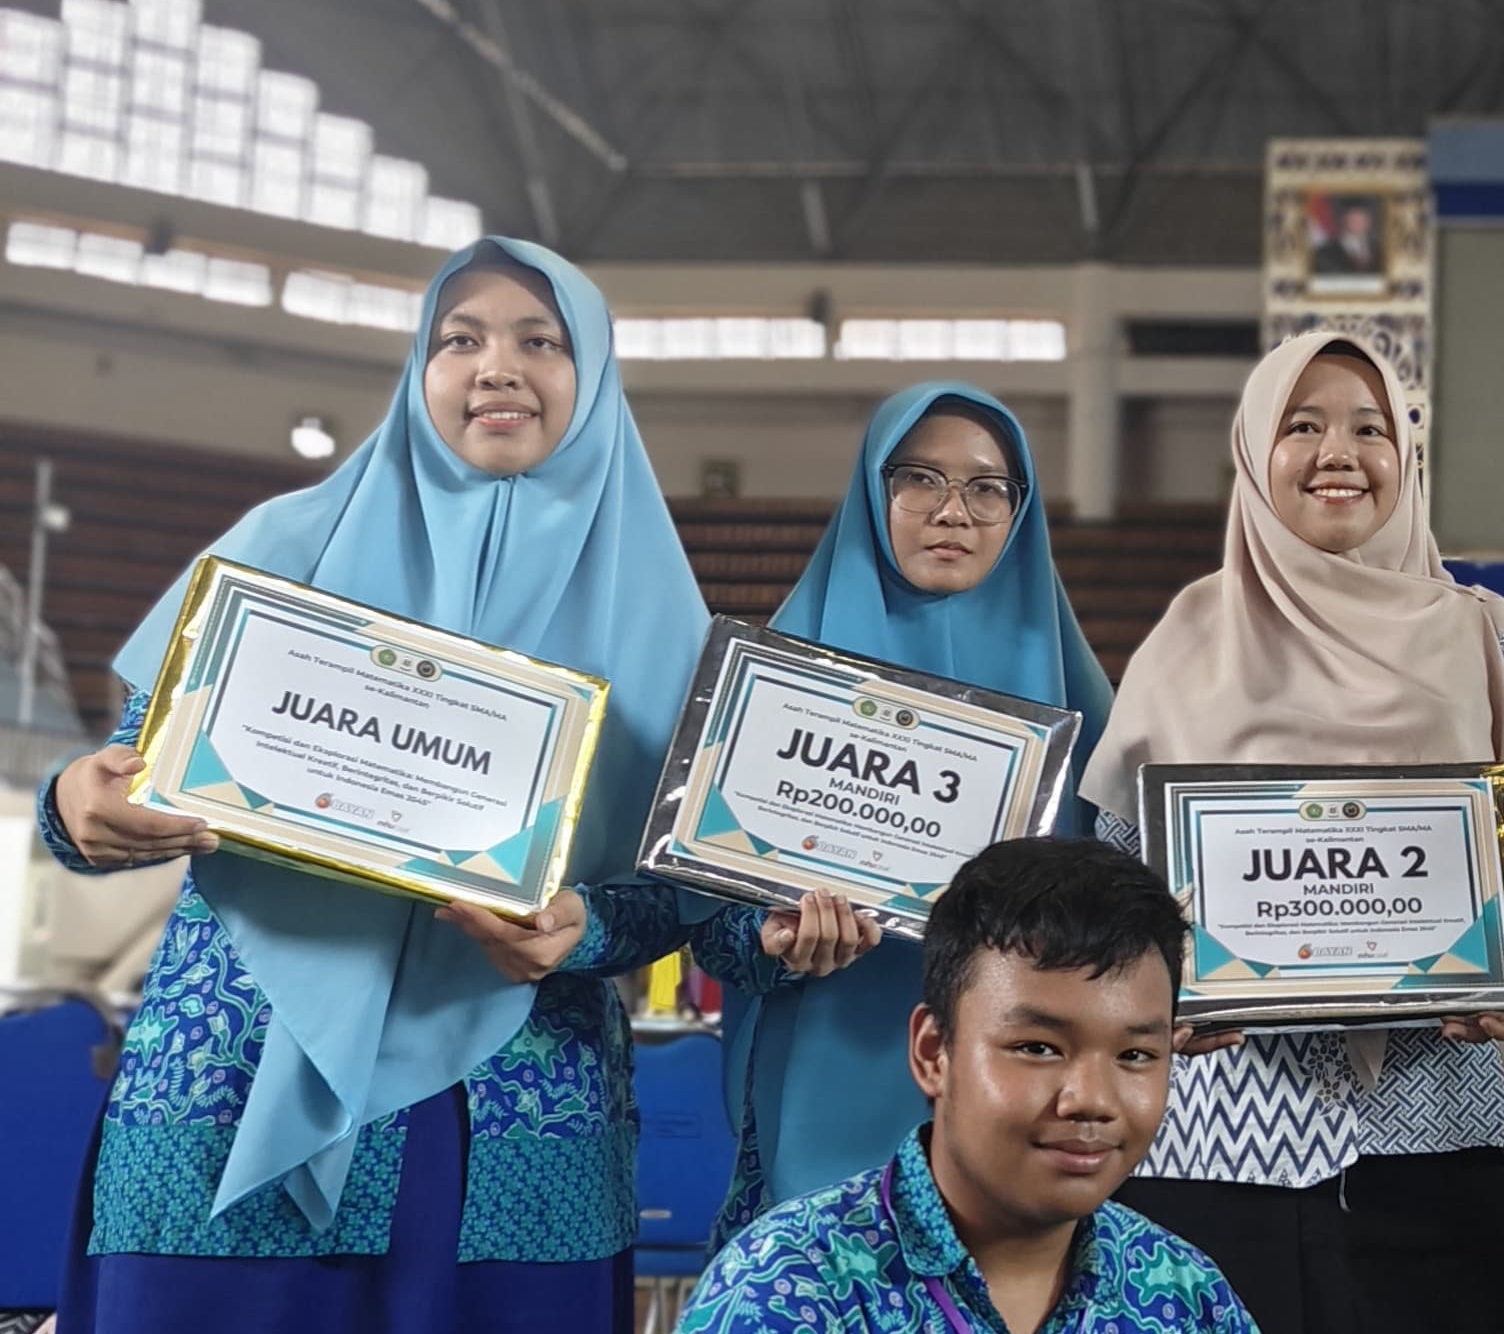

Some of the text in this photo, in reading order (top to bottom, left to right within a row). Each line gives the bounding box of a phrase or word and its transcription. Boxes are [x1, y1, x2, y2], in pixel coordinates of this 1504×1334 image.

[288, 650, 311, 661] Asah
[314, 657, 355, 674] Terampil
[356, 670, 410, 691] Matematika
[436, 694, 469, 709] Tingkat
[365, 685, 429, 708] se-Kalimantan
[271, 690, 491, 775] JUARA UMUM
[777, 728, 962, 804] JUARA 3
[776, 780, 942, 839] Rp200.000,00
[828, 777, 901, 806] MANDIRI
[1242, 846, 1429, 882] JUARA 2
[1303, 882, 1374, 896] MANDIRI
[1257, 896, 1422, 921] Rp300.000,00
